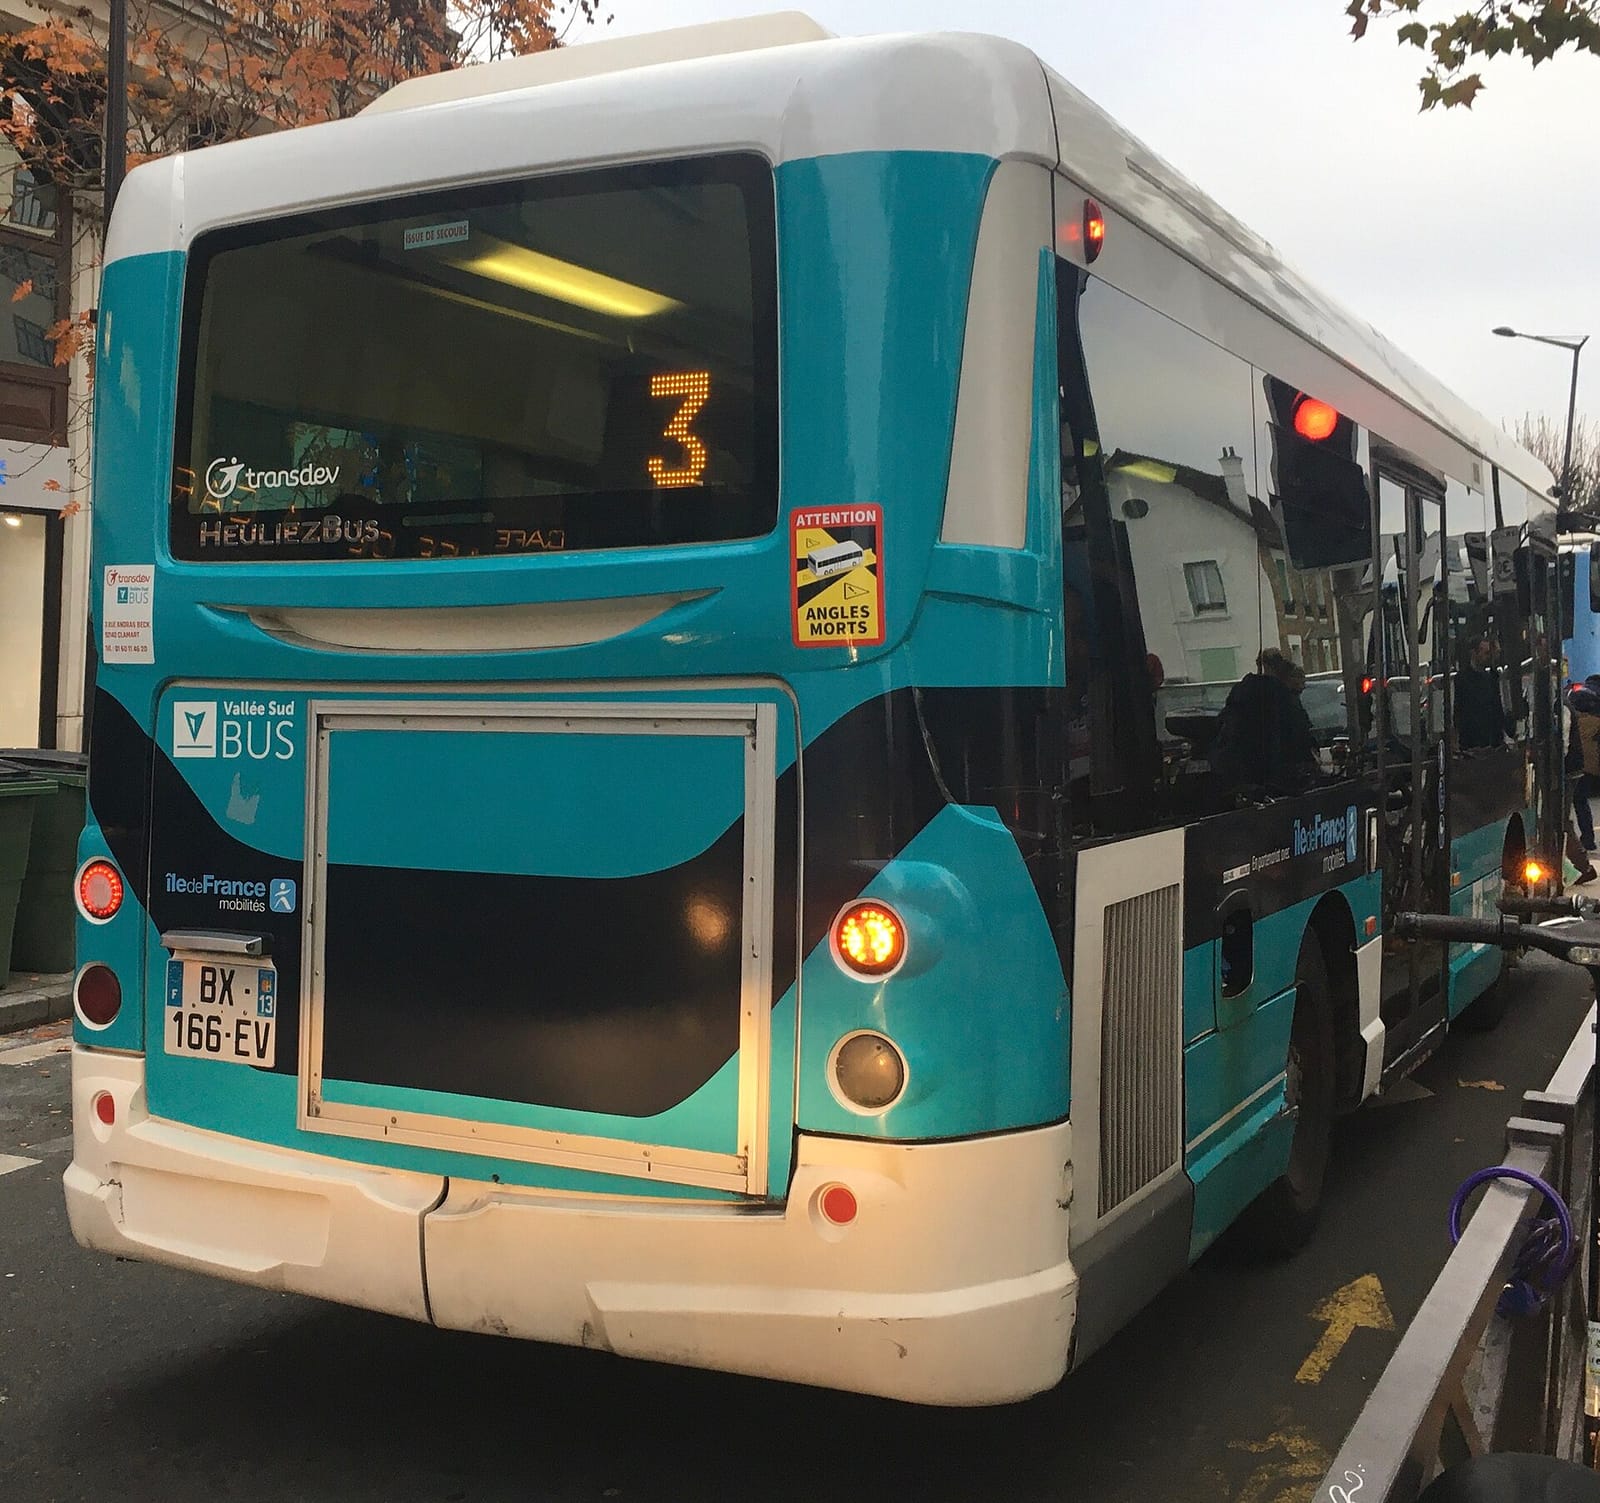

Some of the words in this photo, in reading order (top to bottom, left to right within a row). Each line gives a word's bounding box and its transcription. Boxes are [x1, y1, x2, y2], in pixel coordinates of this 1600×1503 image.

[406, 232, 424, 243] ISSUE
[426, 230, 434, 240] DE
[437, 225, 467, 239] SECOURS
[648, 371, 709, 486] 3
[245, 464, 340, 488] transdev
[796, 510, 876, 527] ATTENTION
[118, 574, 150, 583] transdev
[129, 592, 149, 604] BUS
[806, 605, 870, 621] ANGLES
[810, 621, 867, 636] MORTS
[223, 701, 265, 716] Vallée
[268, 701, 295, 716] Sud
[222, 720, 294, 759] BUS
[219, 898, 266, 912] mobilités
[171, 988, 179, 999] F
[259, 994, 273, 1014] 13
